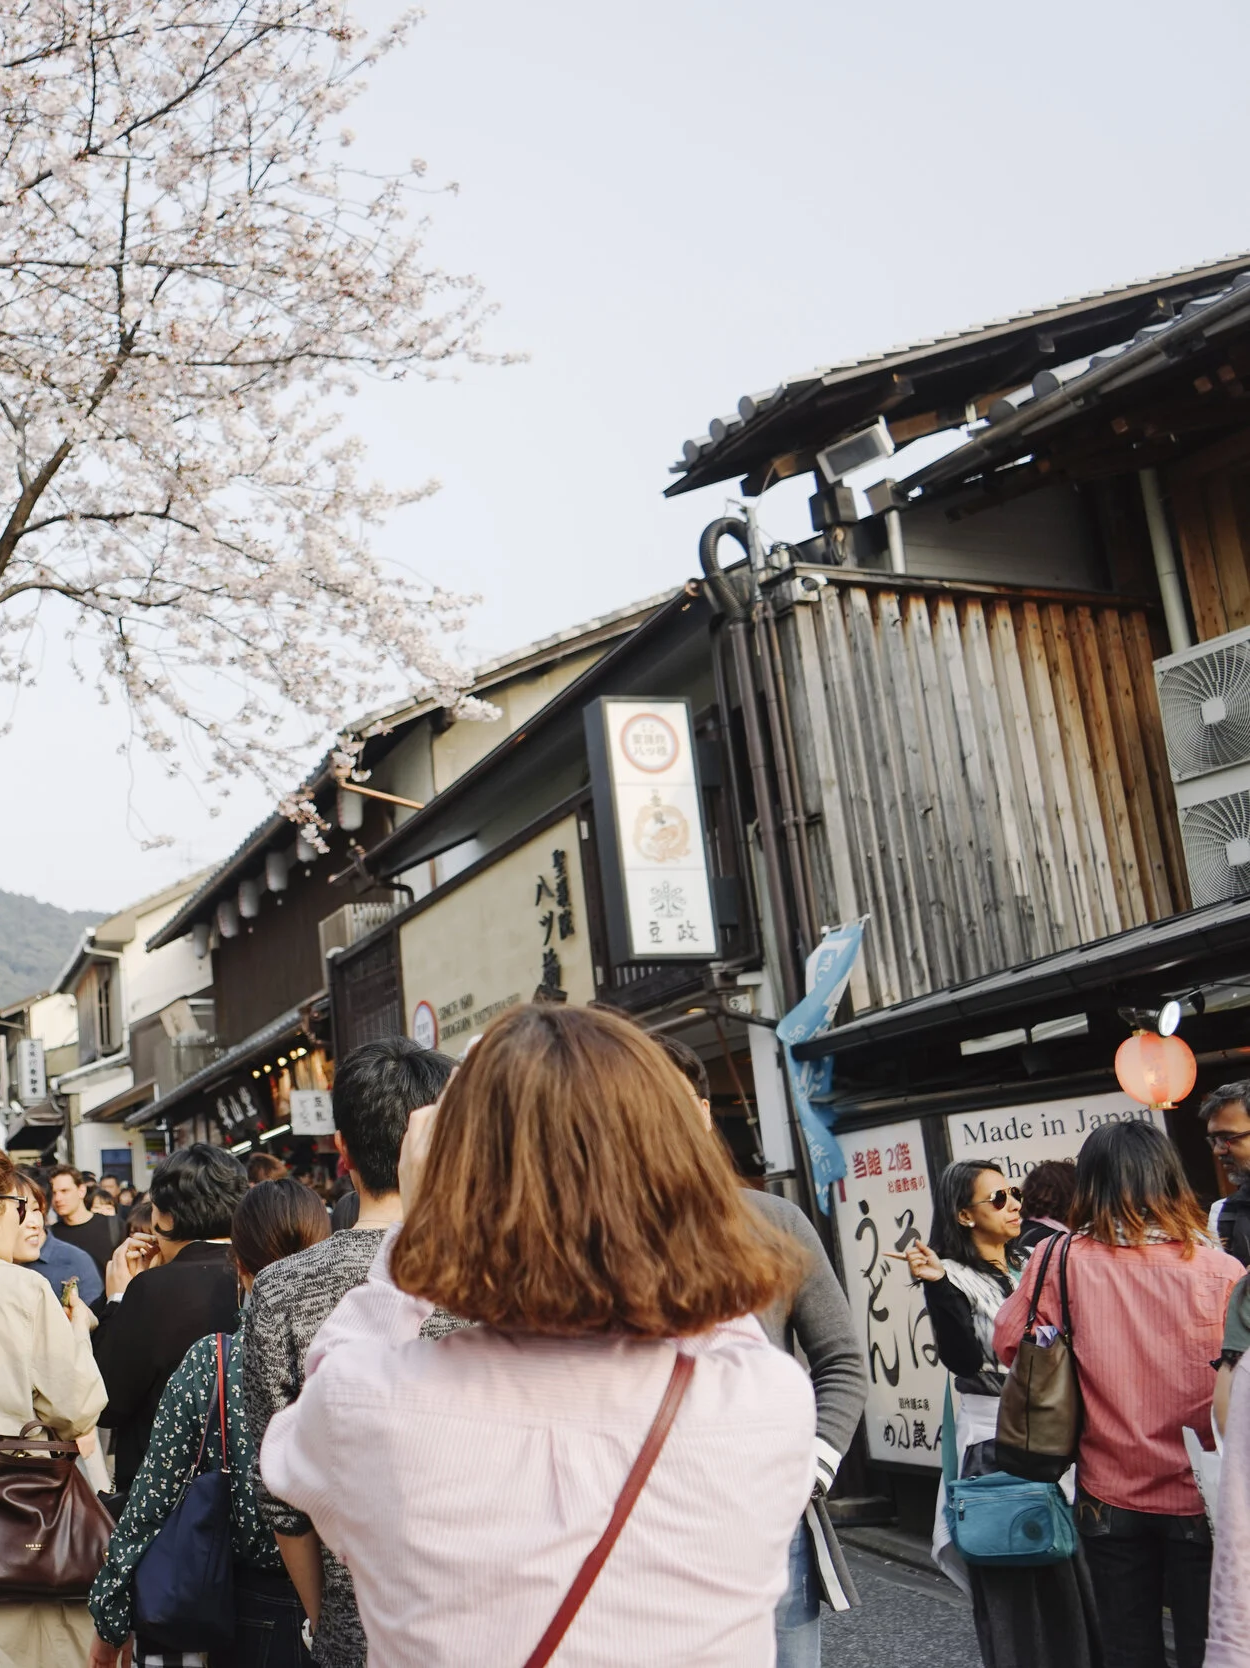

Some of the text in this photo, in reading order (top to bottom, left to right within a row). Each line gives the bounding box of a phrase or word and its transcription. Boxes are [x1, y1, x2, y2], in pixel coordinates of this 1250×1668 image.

[963, 1117, 1033, 1146] Made
[1041, 1113, 1065, 1137] in
[855, 1199, 900, 1387] うどん
